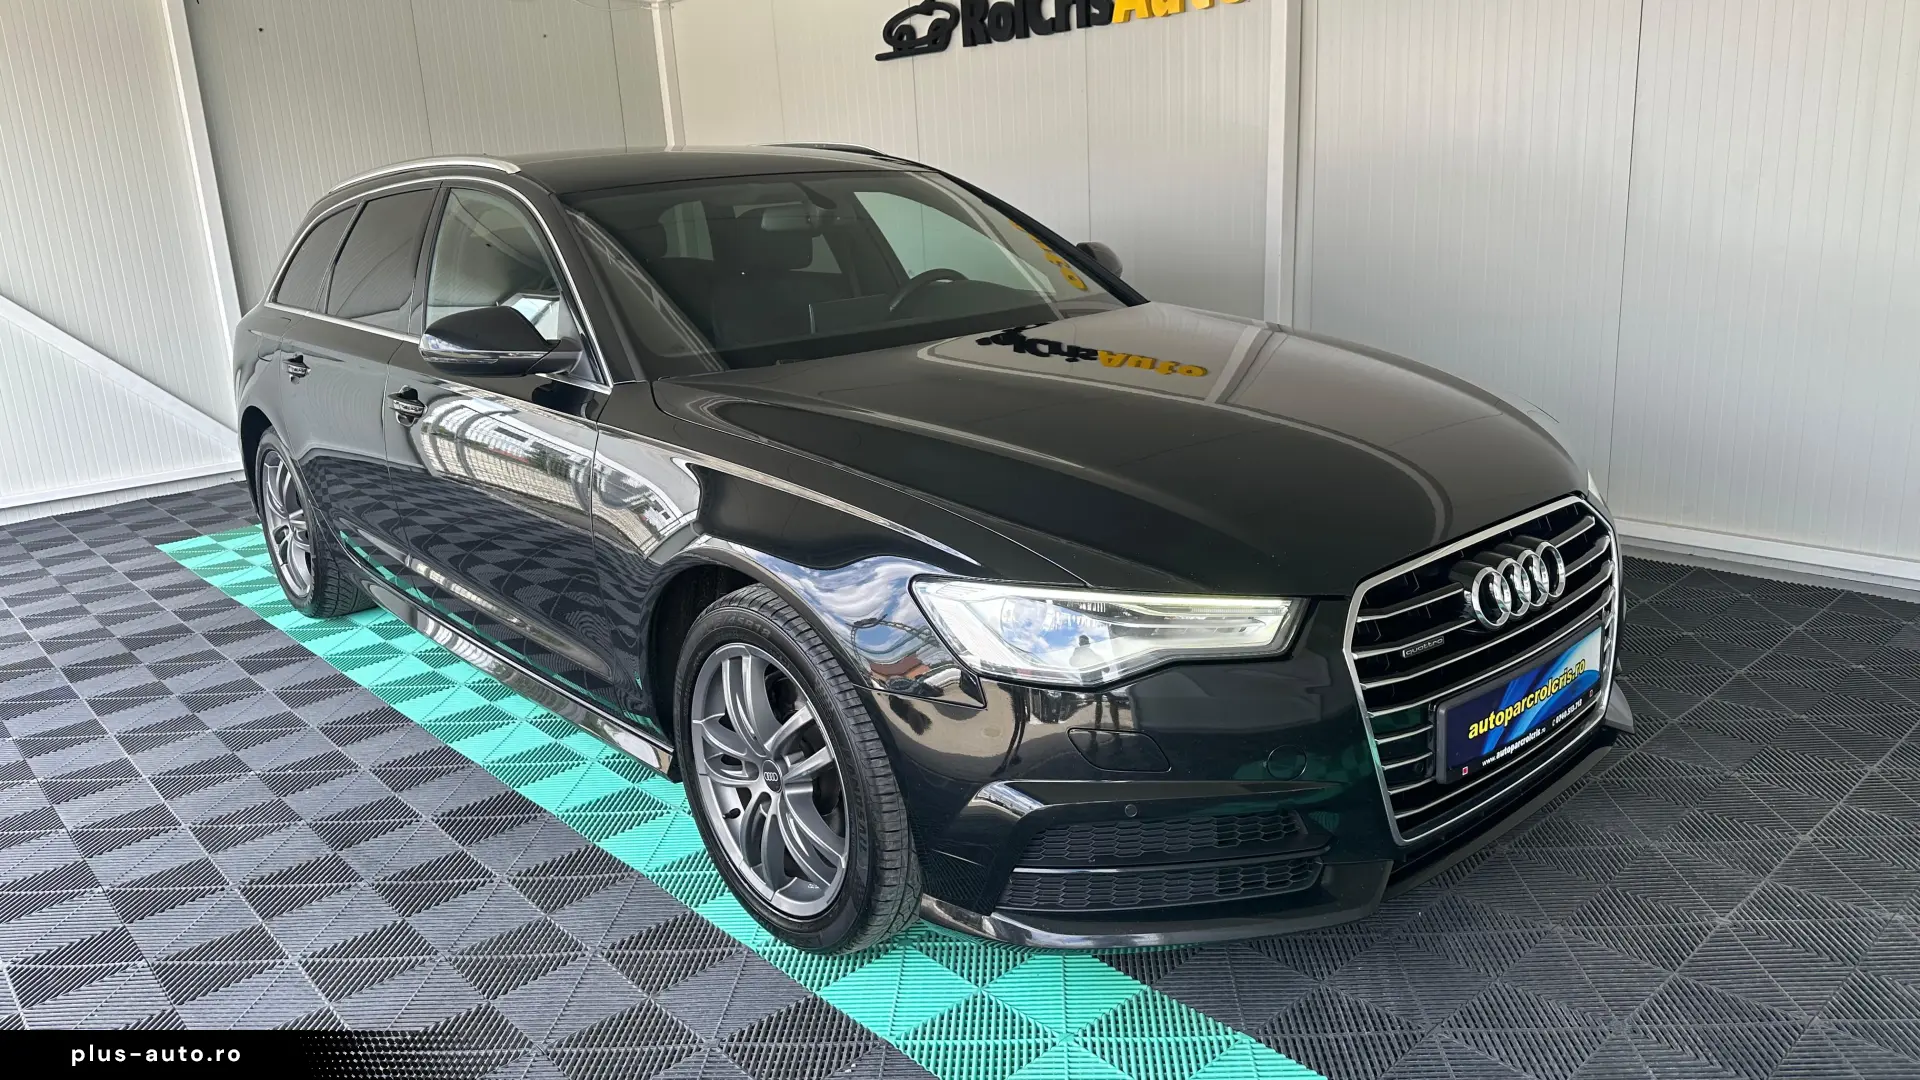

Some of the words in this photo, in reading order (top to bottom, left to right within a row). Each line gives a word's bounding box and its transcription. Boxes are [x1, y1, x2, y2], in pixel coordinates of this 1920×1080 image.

[962, 0, 1247, 48] RolCris
[1405, 638, 1443, 656] quattro
[1467, 659, 1587, 740] autoparcrolcris.ro
